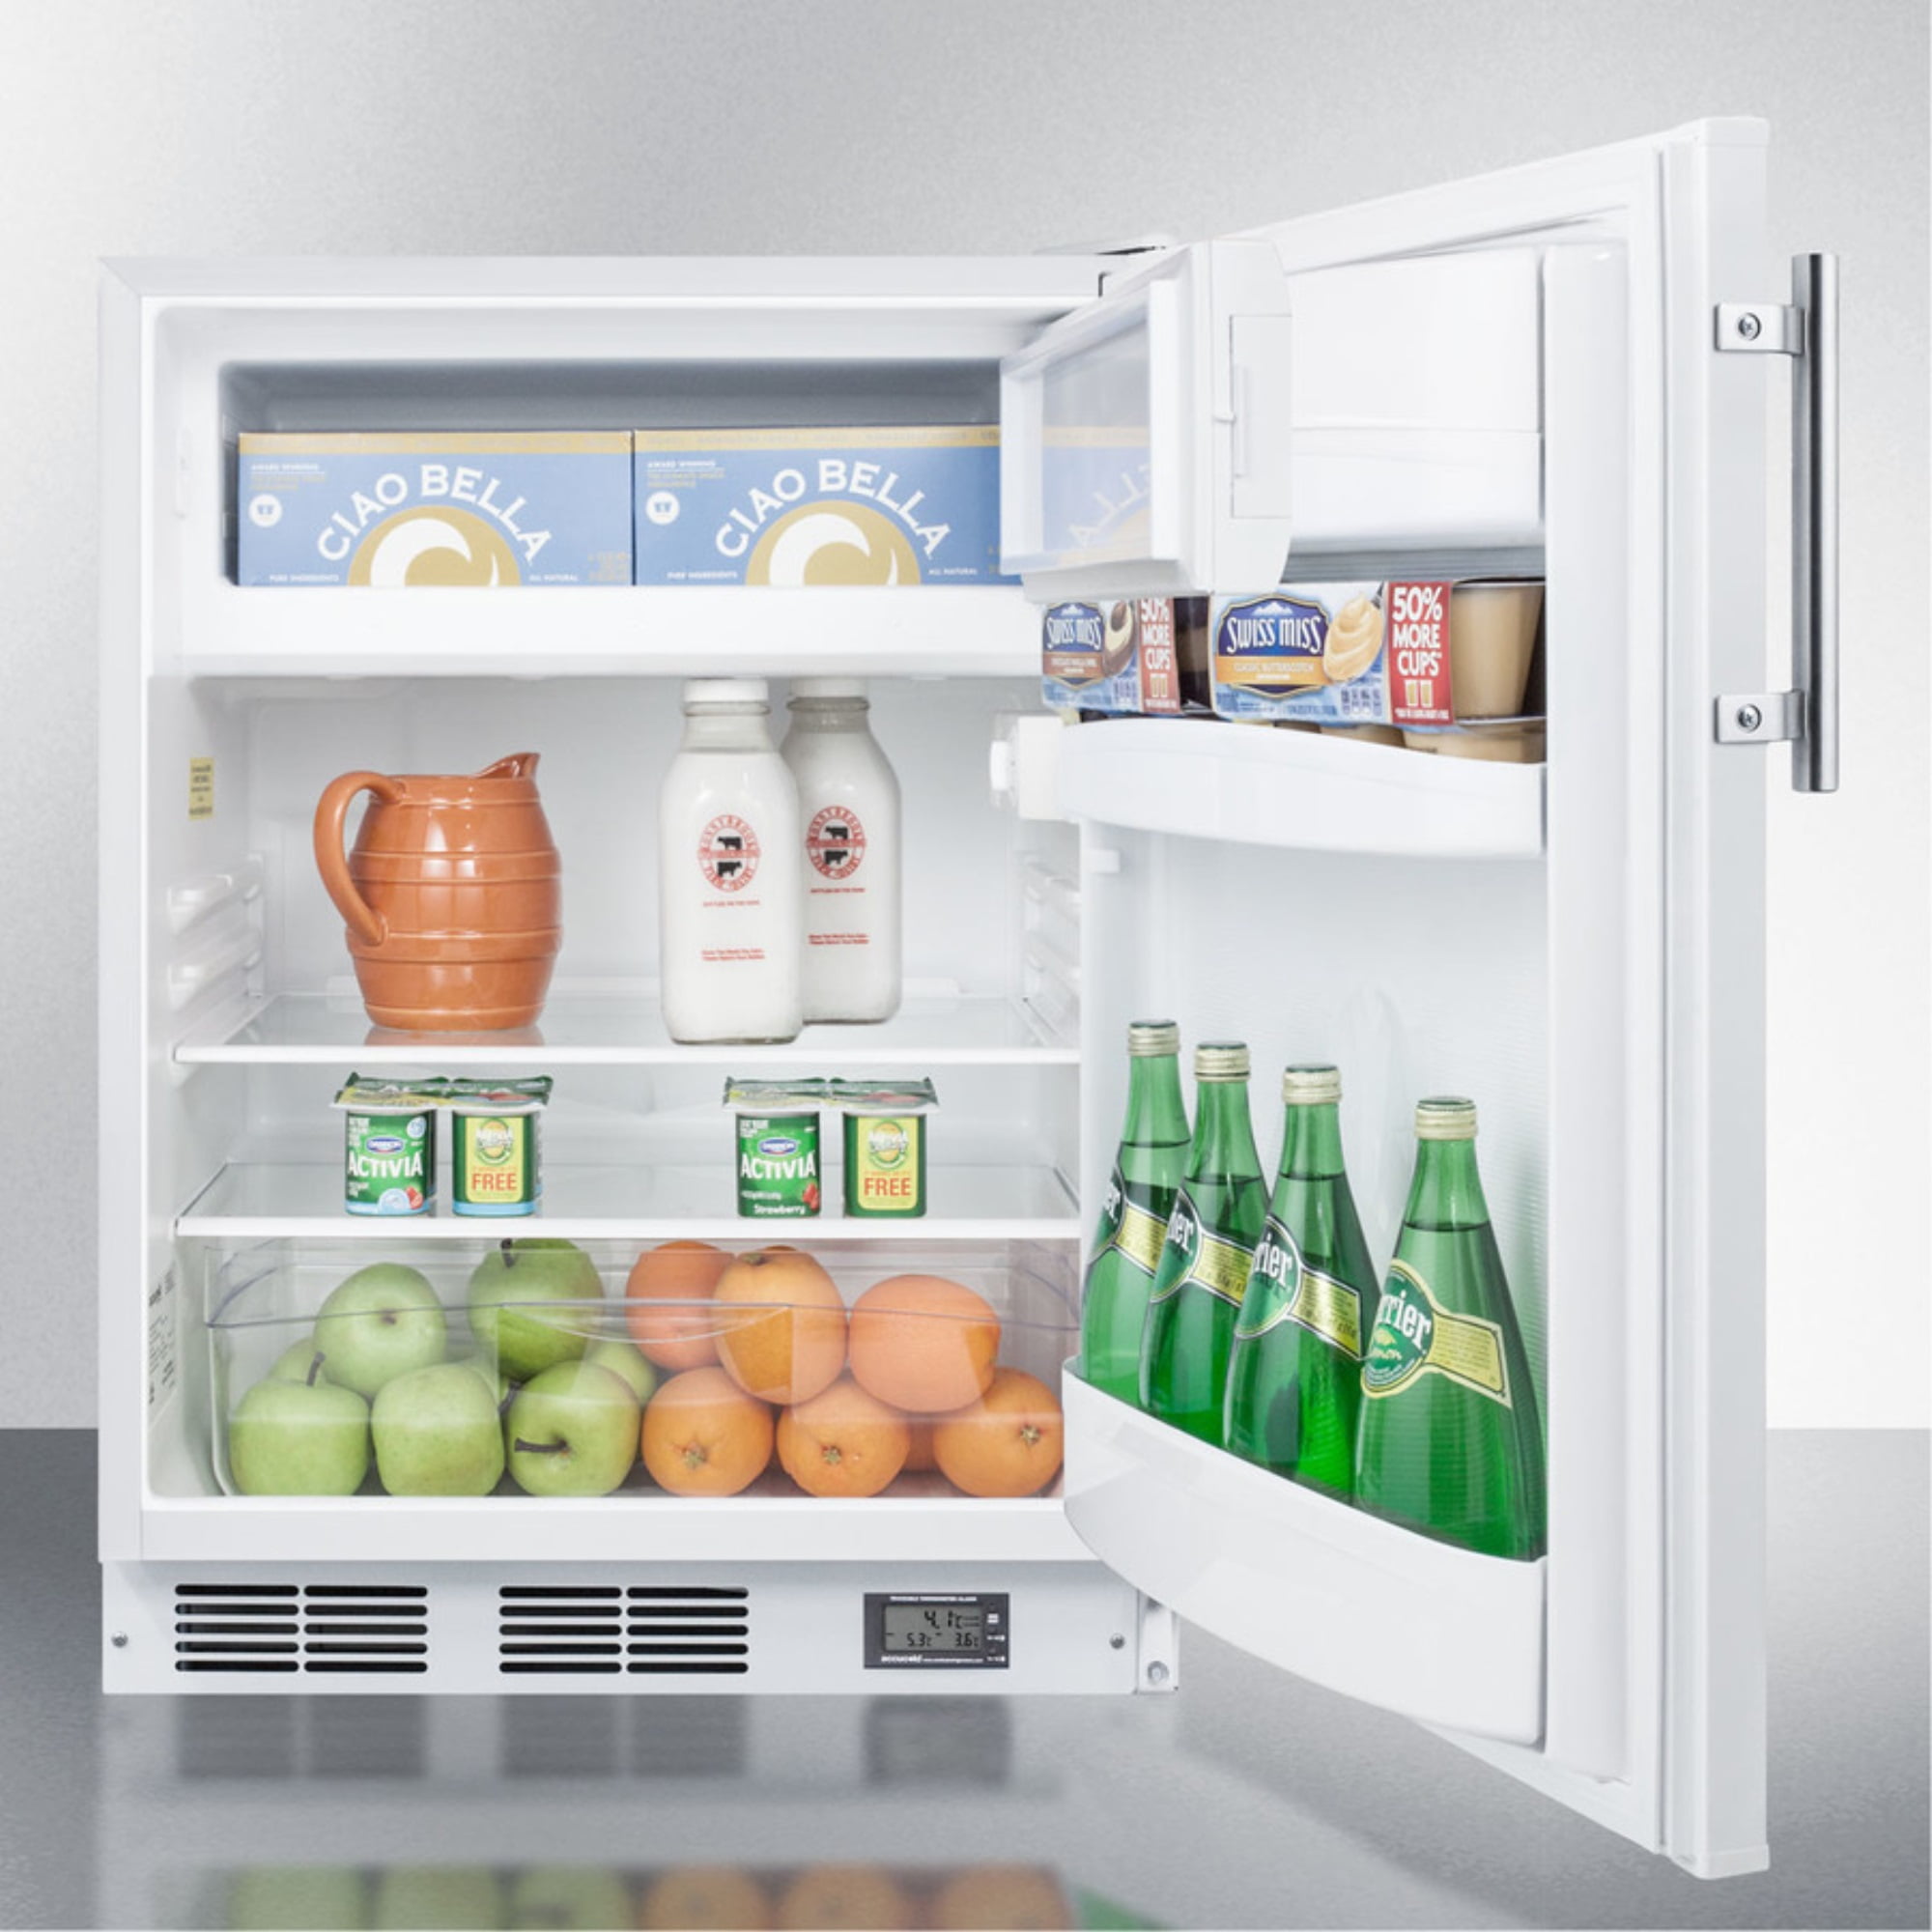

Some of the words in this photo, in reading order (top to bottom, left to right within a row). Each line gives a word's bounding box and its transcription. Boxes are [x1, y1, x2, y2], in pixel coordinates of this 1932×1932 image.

[318, 472, 409, 561] CIAO
[420, 464, 553, 563] BELLA
[716, 469, 807, 557] CIAO
[818, 459, 952, 557] BELLA
[1392, 586, 1443, 622] 50%
[1227, 615, 1277, 655] SWISS
[1279, 615, 1322, 656] MISS
[1392, 623, 1441, 649] MORE
[348, 1151, 423, 1178] ACTIVIA
[741, 1151, 816, 1179] ACTIVIA
[471, 1173, 518, 1191] FREE
[864, 1178, 912, 1196] FREE
